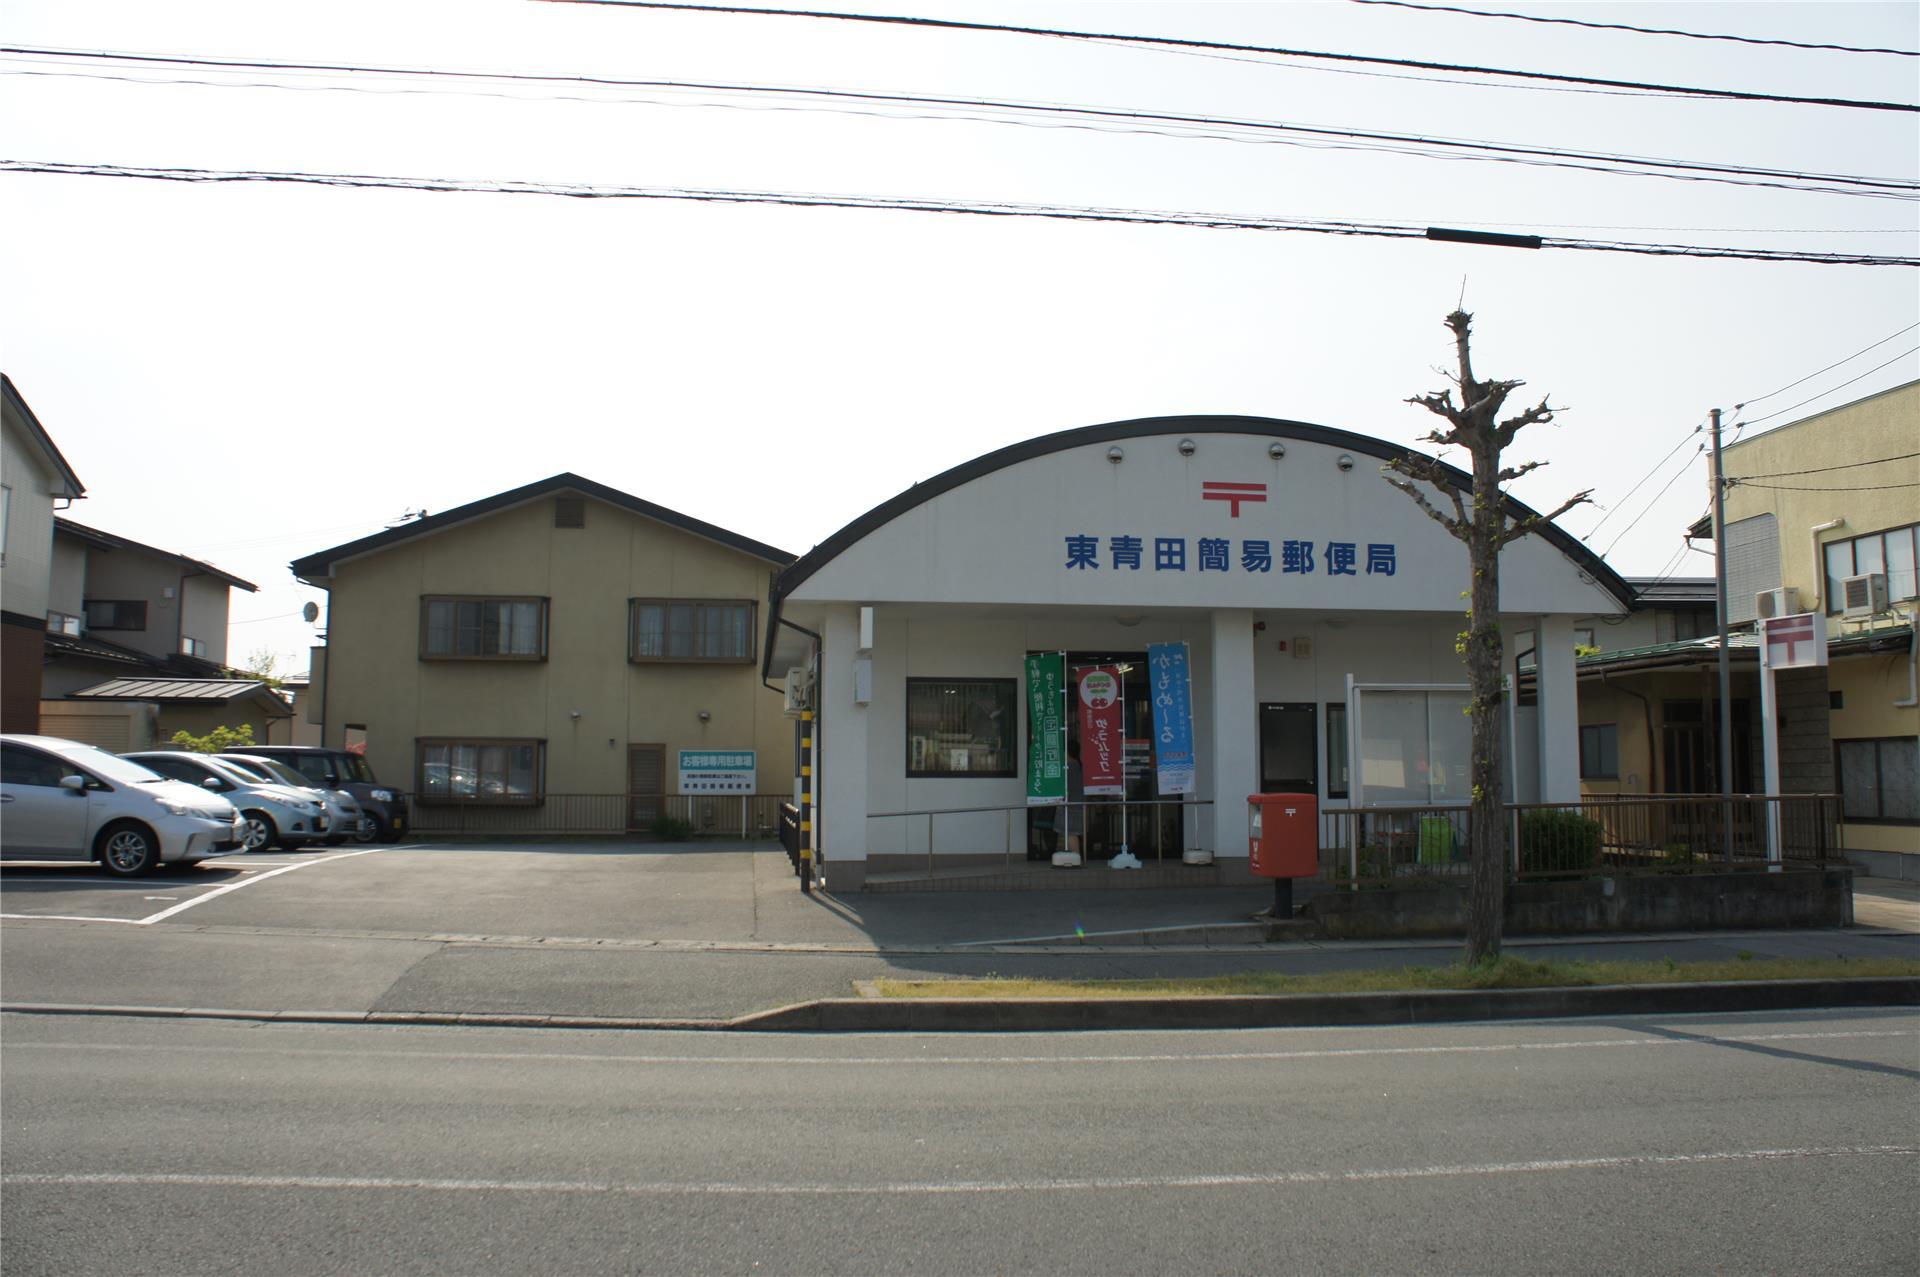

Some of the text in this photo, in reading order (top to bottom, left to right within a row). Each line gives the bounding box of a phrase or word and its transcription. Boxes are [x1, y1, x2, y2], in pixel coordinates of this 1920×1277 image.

[1065, 535, 1397, 576] 東青田簡易郵便局
